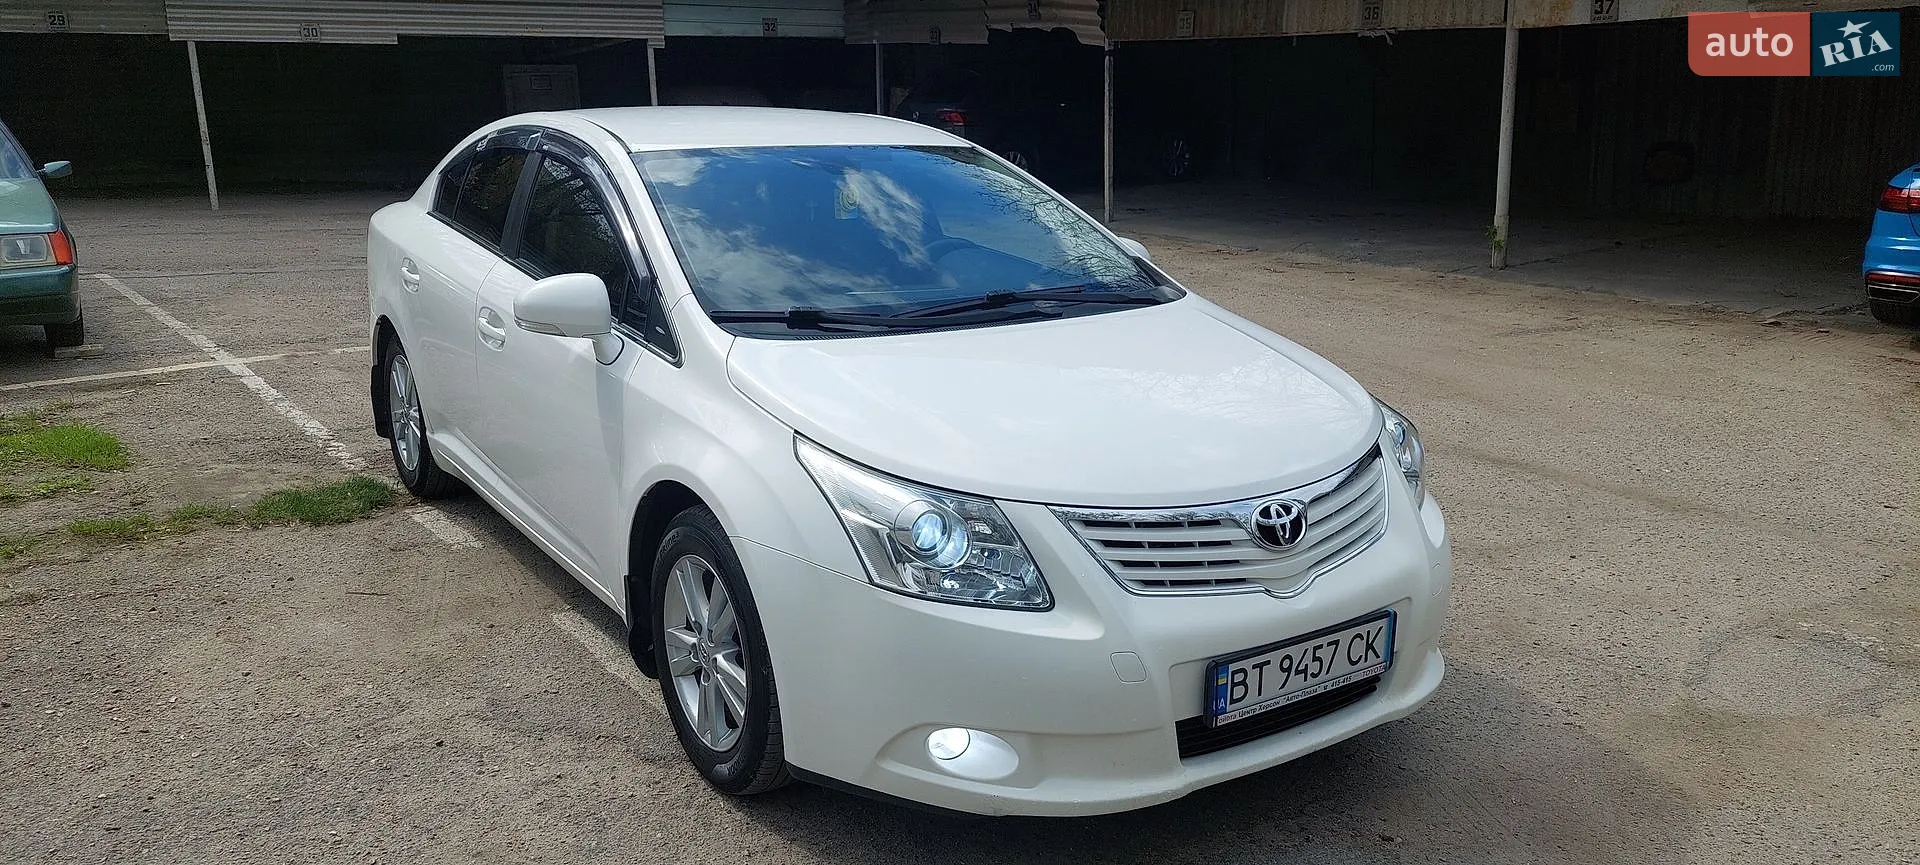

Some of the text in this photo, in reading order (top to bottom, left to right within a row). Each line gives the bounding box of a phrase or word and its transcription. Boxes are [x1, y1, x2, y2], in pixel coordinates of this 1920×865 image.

[1364, 6, 1379, 20] 36
[1594, 0, 1614, 15] 37
[303, 27, 318, 38] 30
[764, 22, 776, 31] 32
[1229, 625, 1384, 705] BT 9457 CK
[1258, 700, 1281, 712] Херсон
